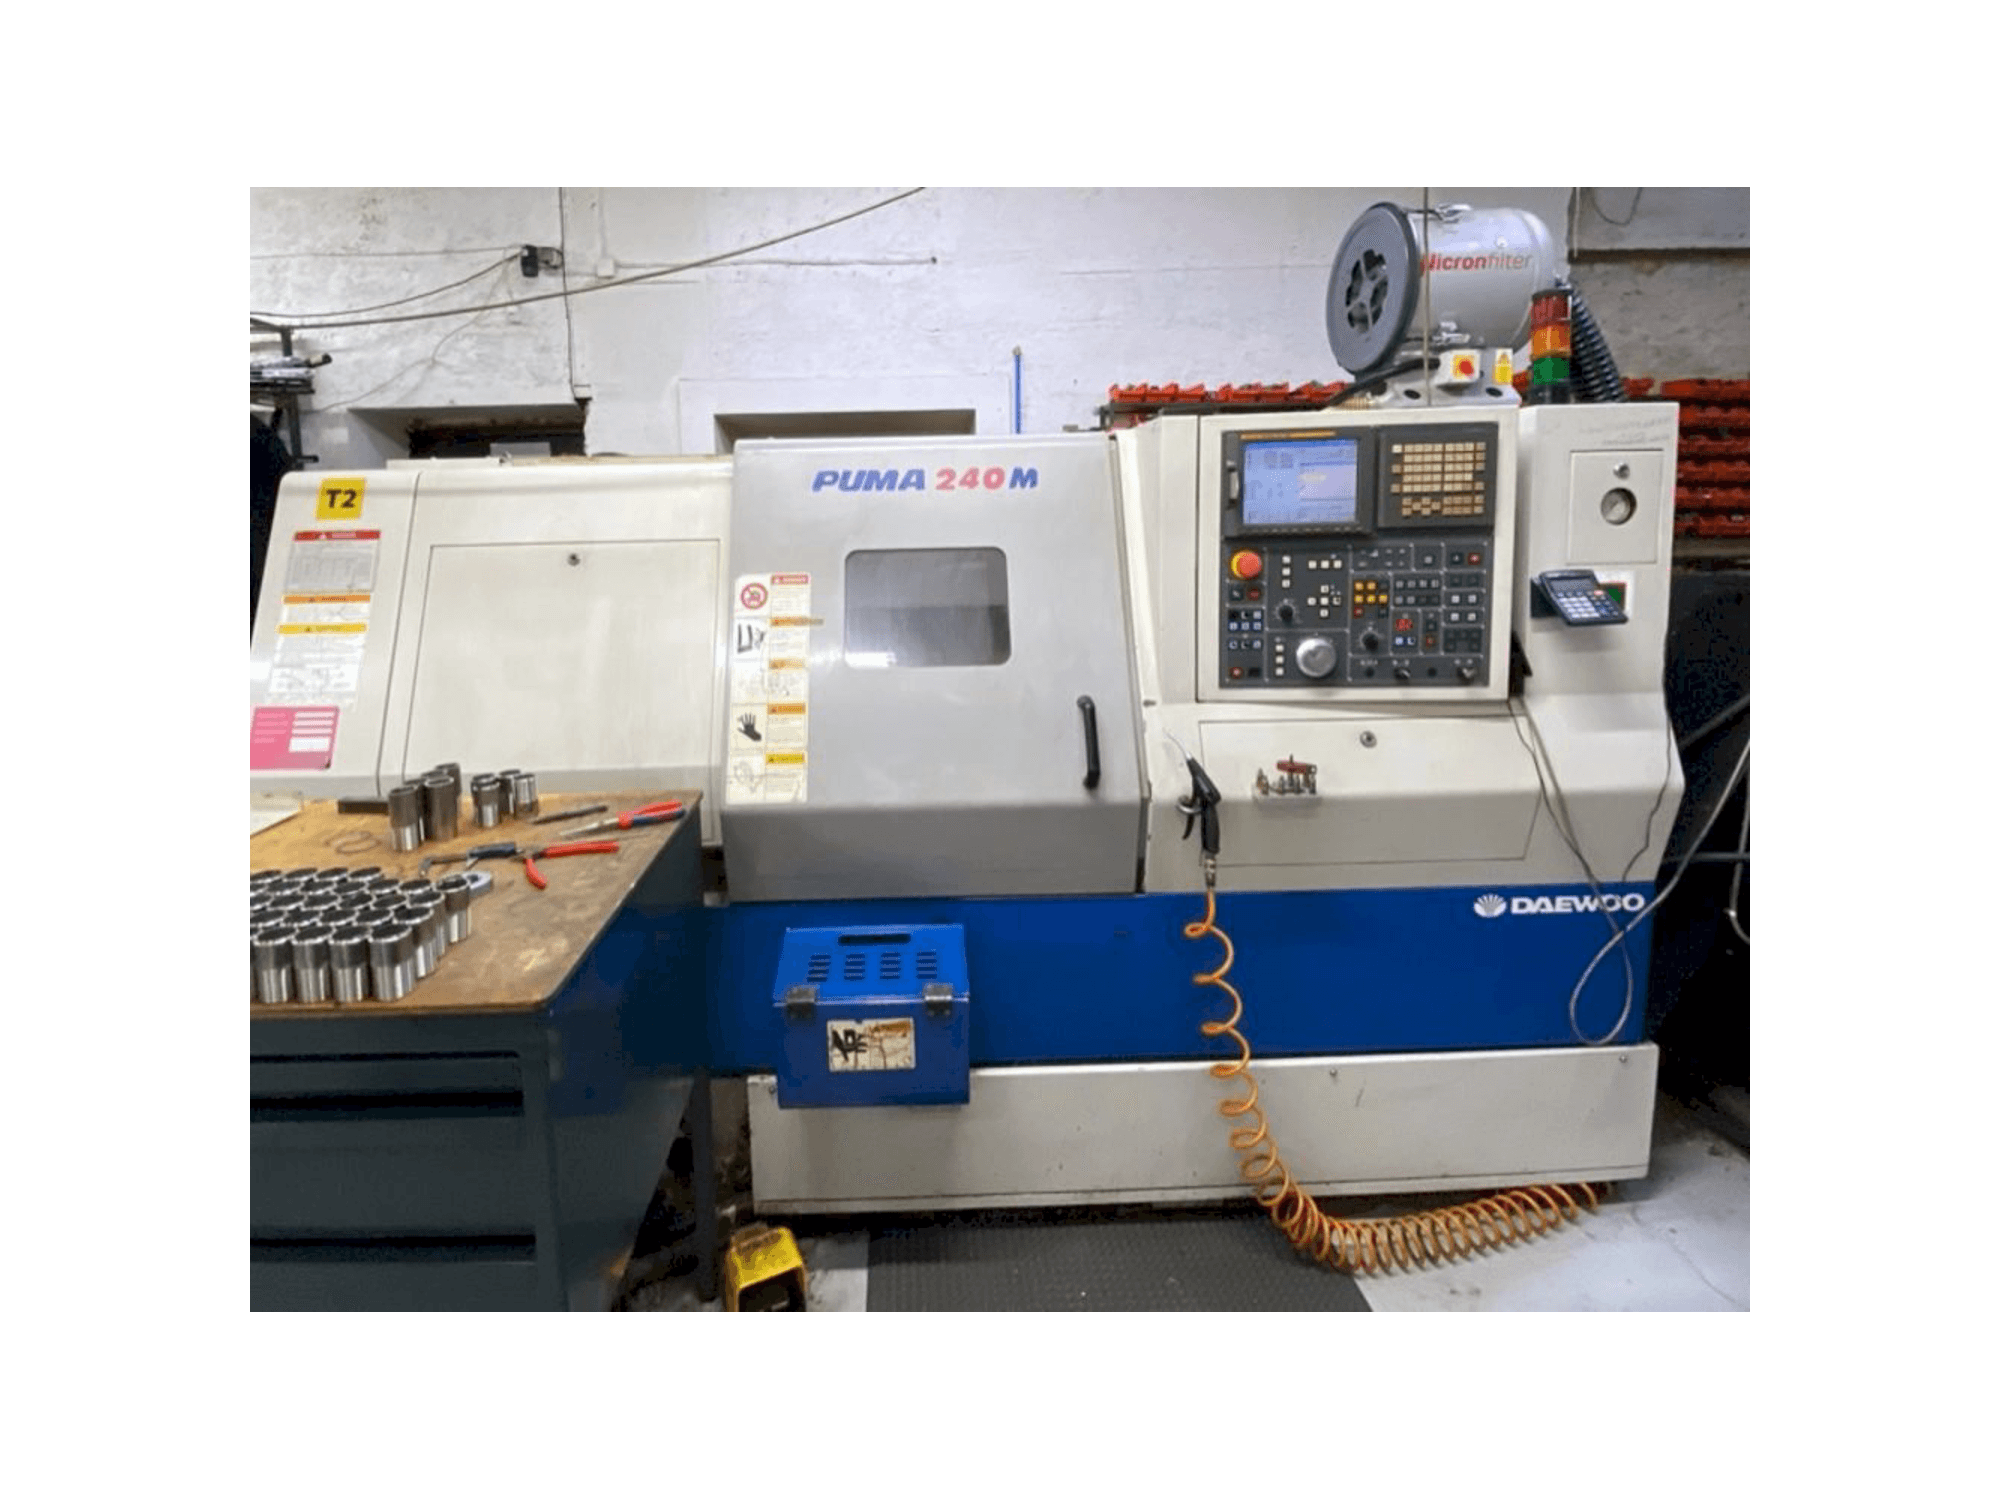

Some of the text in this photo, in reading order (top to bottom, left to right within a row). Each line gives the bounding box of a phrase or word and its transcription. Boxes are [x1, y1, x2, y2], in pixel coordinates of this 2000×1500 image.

[812, 469, 926, 492] PUMA
[326, 488, 357, 509] T2
[1510, 893, 1645, 915] DAEWOO
